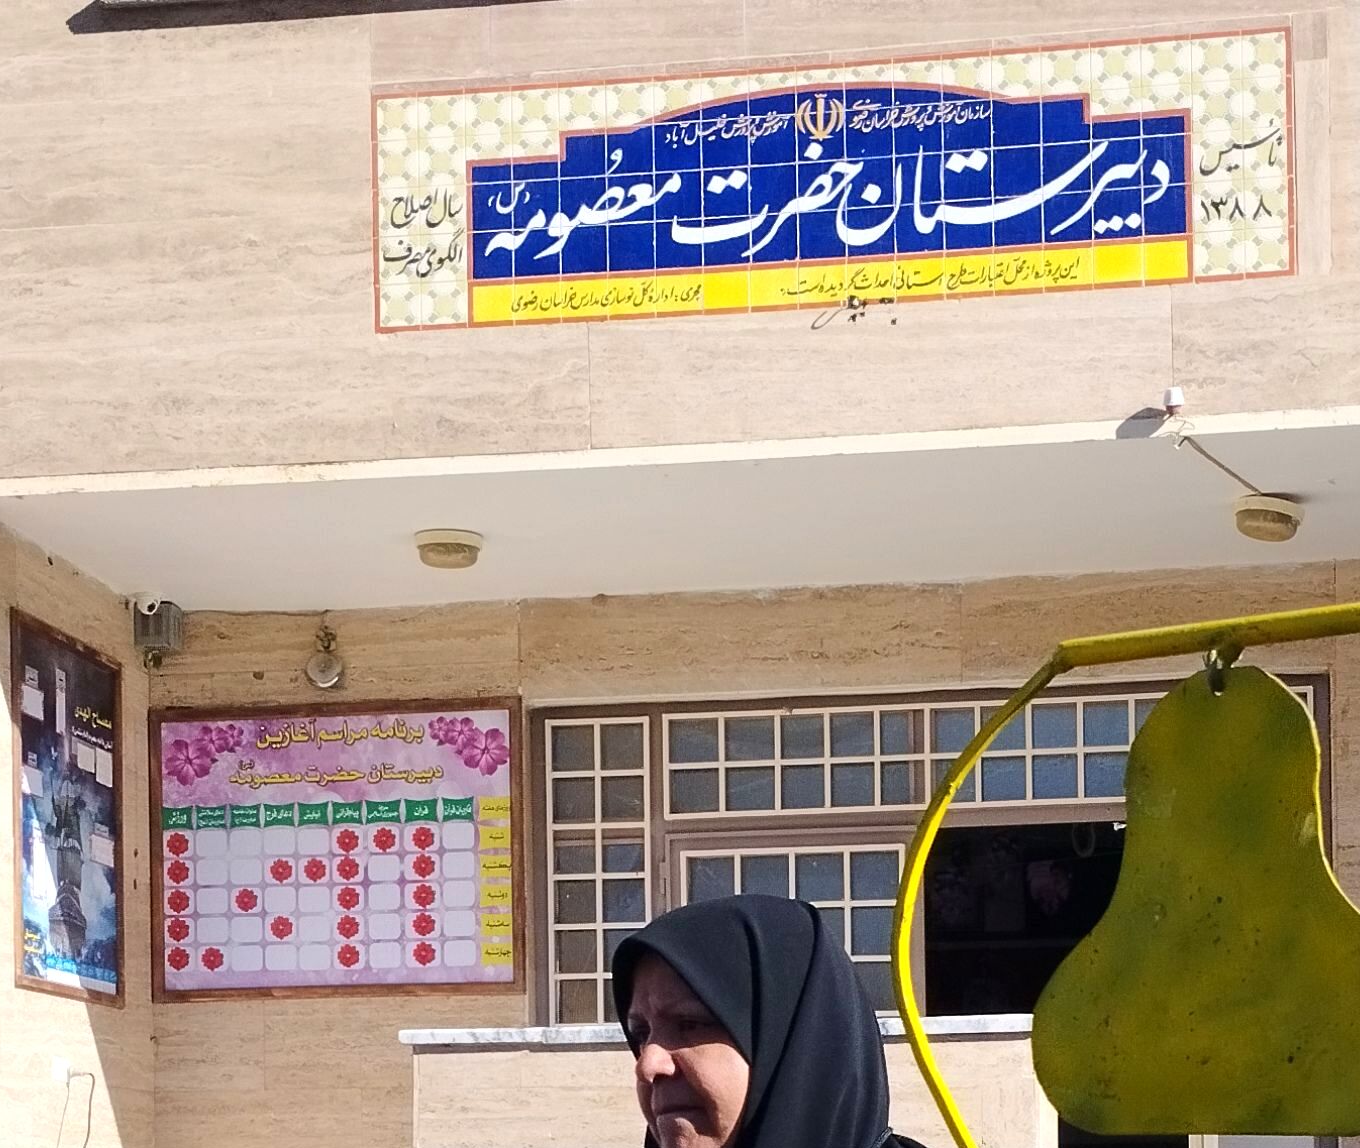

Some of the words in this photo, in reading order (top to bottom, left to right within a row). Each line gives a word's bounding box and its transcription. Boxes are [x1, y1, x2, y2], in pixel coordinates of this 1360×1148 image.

[671, 142, 864, 258] حضرت
[836, 141, 1170, 246] دبیرستان
[390, 187, 438, 229] اصلاح
[425, 187, 463, 229] سال
[1022, 265, 1035, 280] از
[1034, 260, 1061, 283] پروژه
[1060, 256, 1080, 280] این
[854, 272, 895, 290] احداث
[575, 289, 600, 307] مدارس
[601, 287, 634, 307] نوسازی
[256, 718, 318, 750] آغازین
[317, 720, 369, 749] مراسم
[371, 718, 425, 744] برنامه
[229, 769, 303, 789] معصومه
[304, 764, 365, 787] حضرت
[367, 762, 444, 785] دبیرستان
